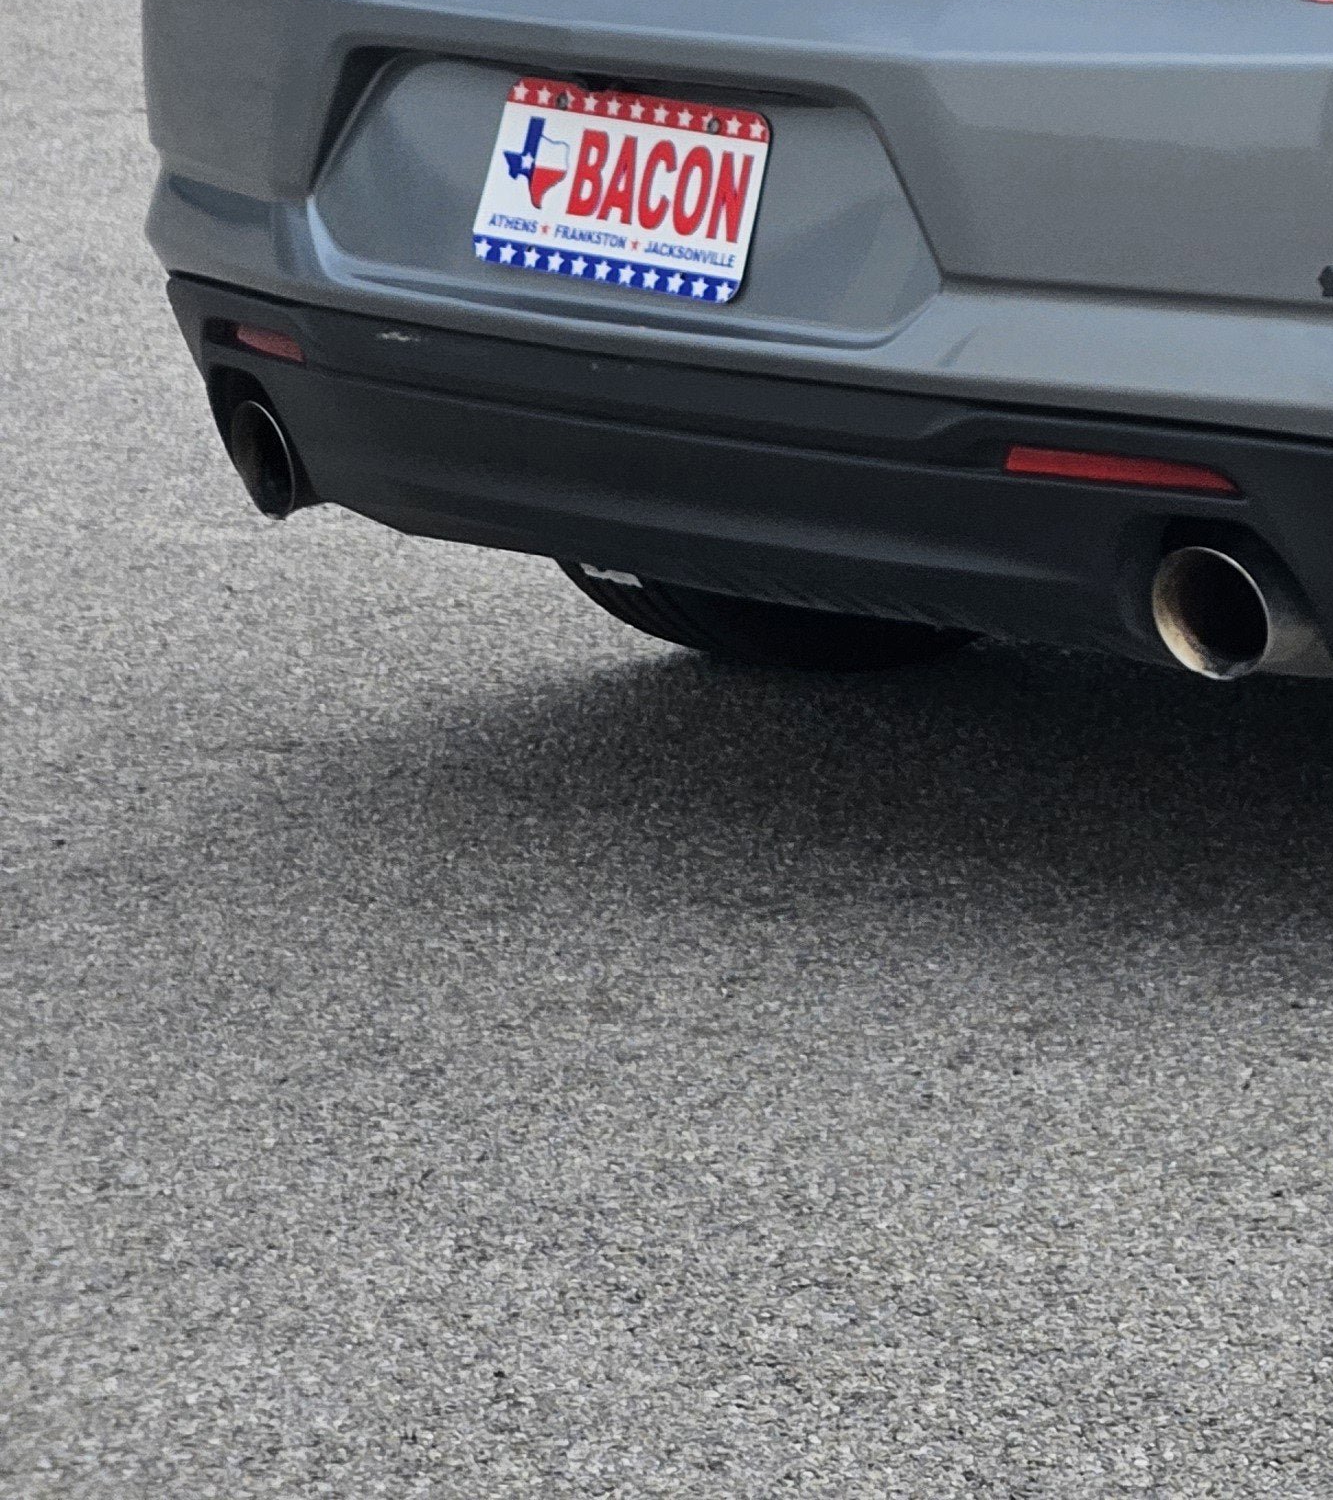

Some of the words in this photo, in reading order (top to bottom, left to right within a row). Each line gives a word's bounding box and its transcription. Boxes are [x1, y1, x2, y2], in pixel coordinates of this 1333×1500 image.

[565, 128, 754, 244] BACON
[488, 212, 538, 234] ATHENS
[554, 225, 627, 249] FRANKSTON
[643, 240, 736, 269] JACKSONVILLE
